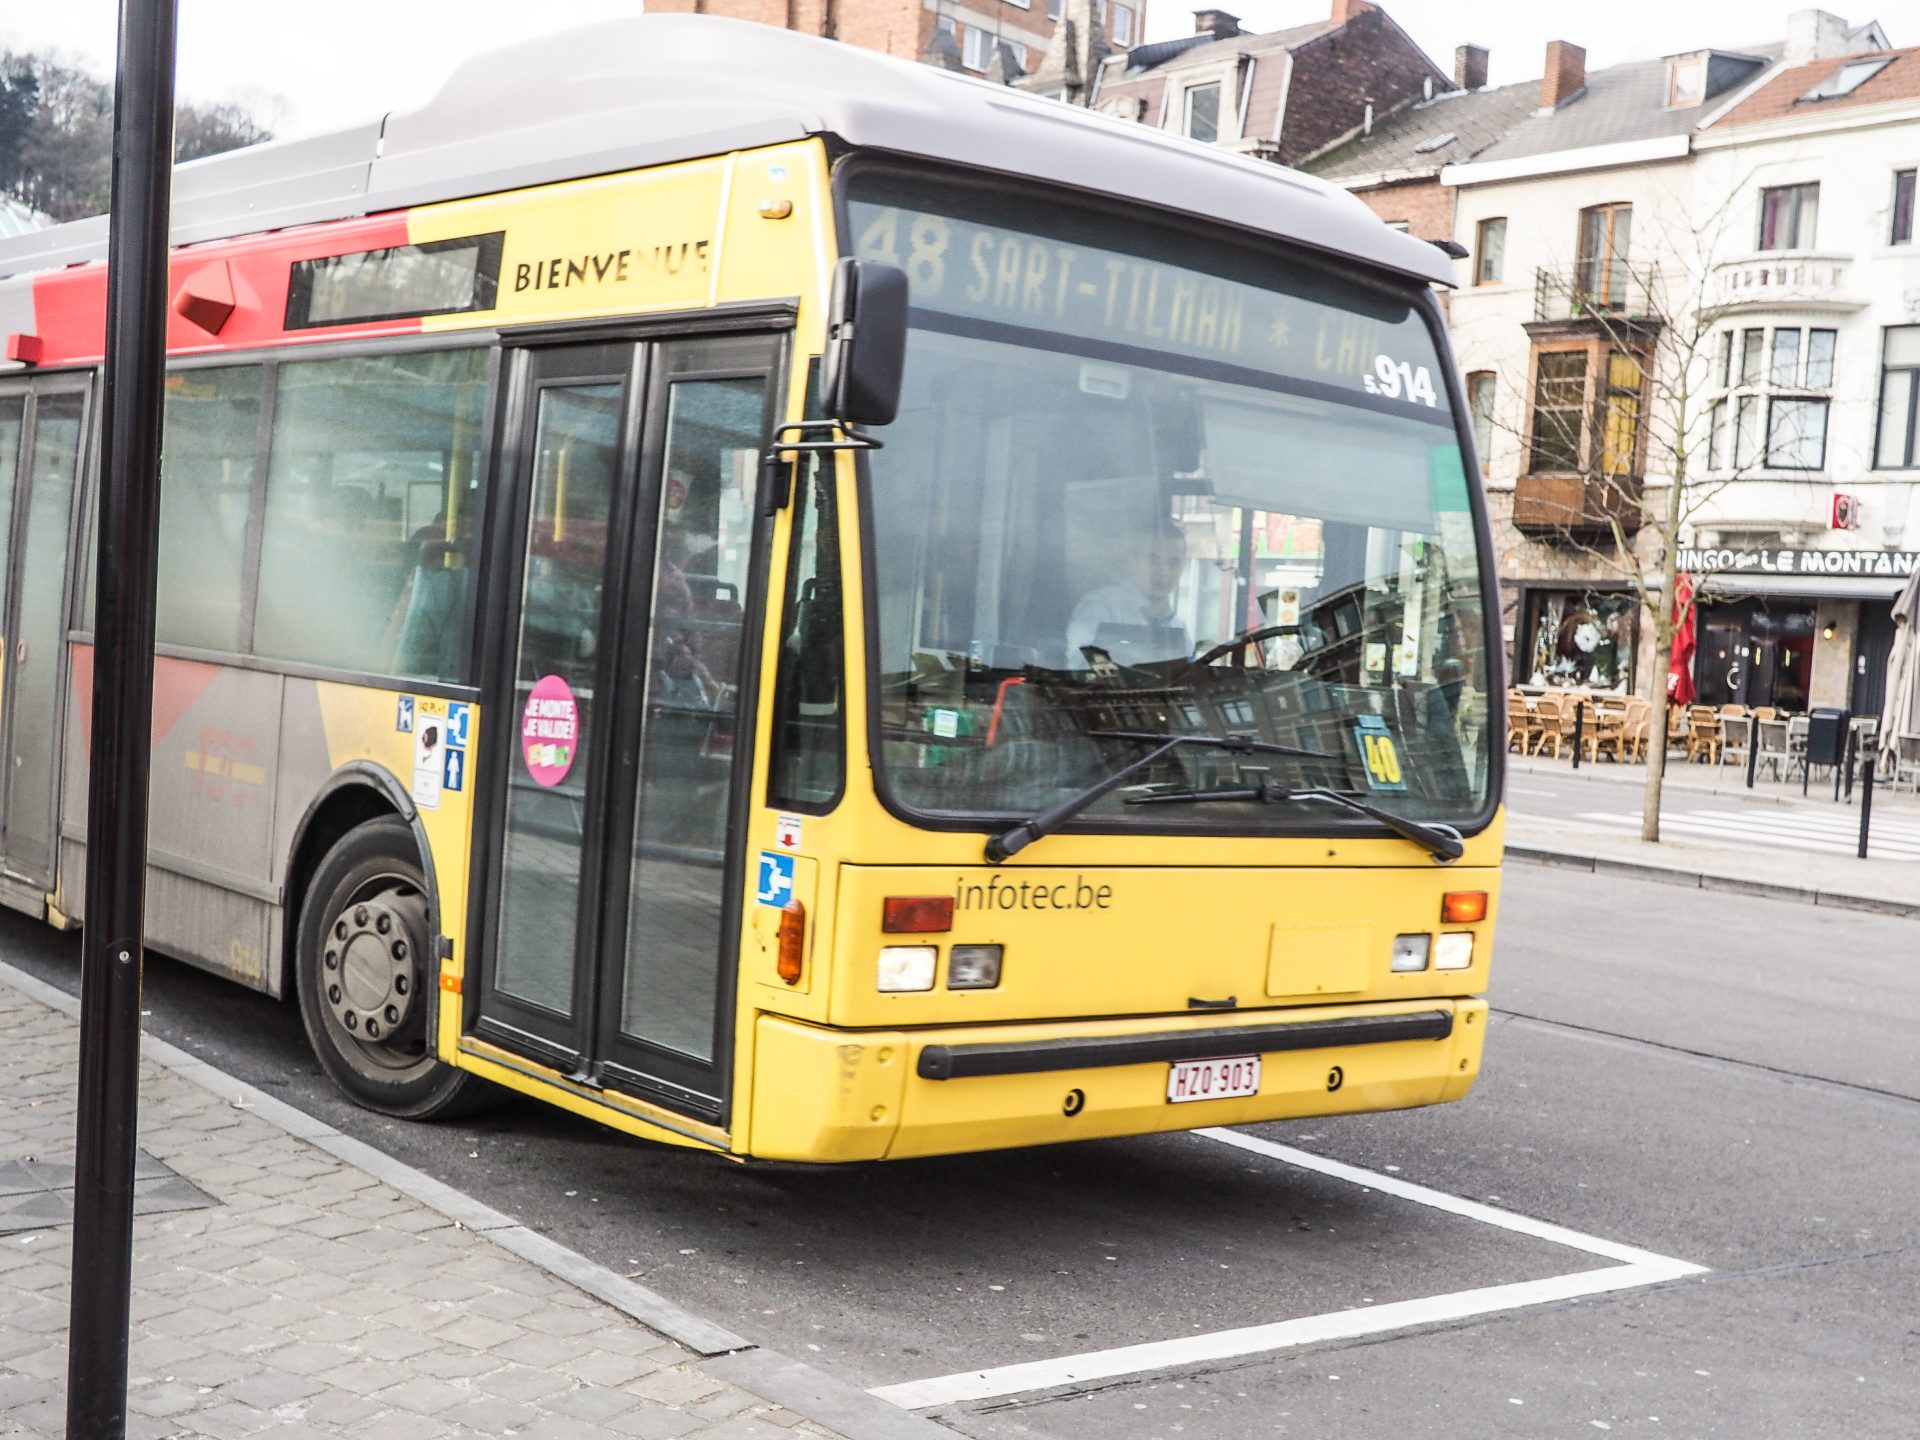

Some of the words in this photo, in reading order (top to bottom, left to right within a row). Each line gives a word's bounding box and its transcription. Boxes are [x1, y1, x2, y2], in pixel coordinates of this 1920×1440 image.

[857, 207, 949, 298] 48
[966, 231, 1244, 352] SART-TILMAN
[1761, 550, 1794, 571] LE
[1364, 735, 1402, 783] 40
[955, 874, 1113, 910] infotec.be
